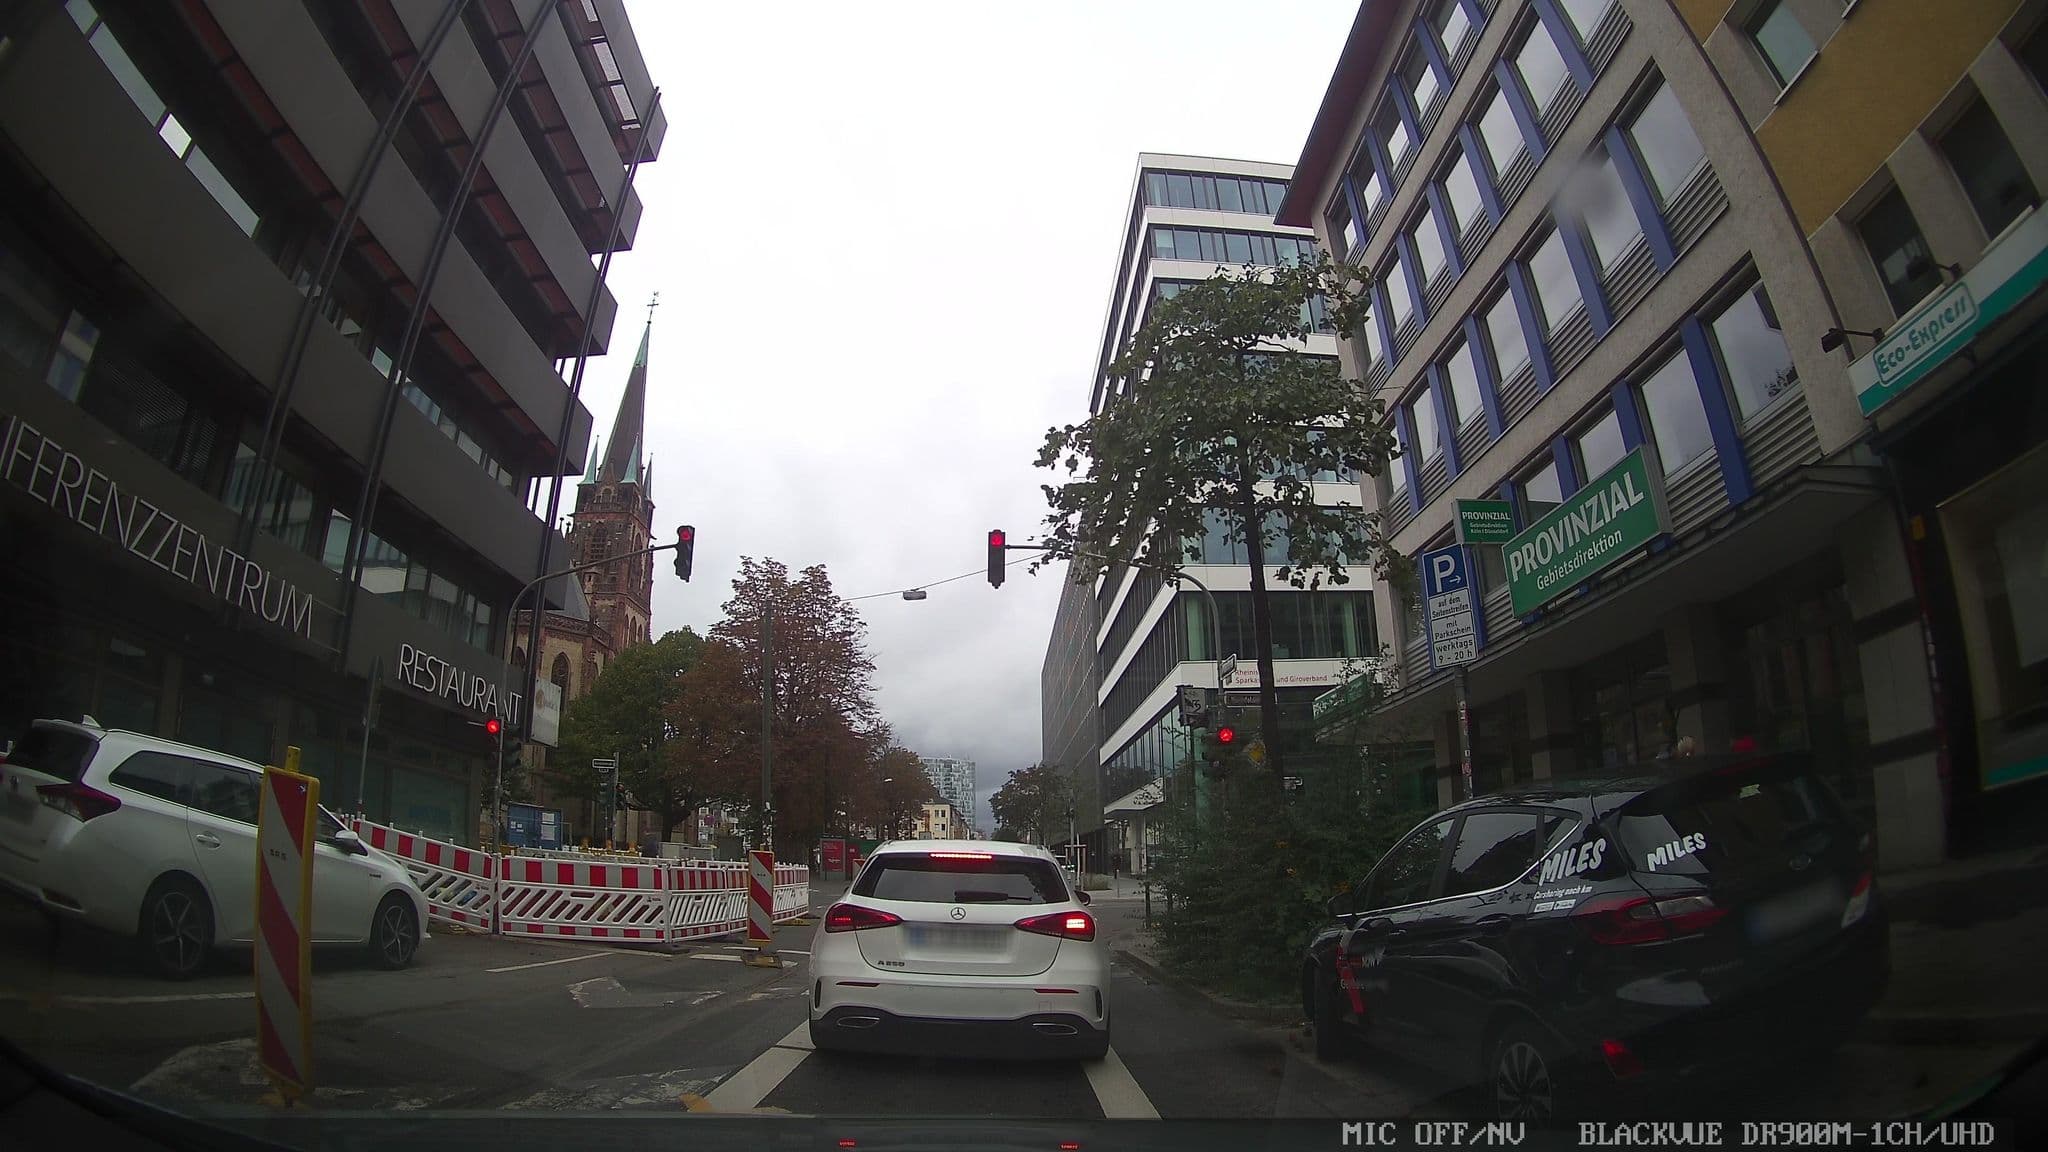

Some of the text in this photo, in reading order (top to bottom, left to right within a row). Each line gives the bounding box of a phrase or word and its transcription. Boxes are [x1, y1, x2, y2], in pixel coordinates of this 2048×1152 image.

[1877, 296, 1967, 375] Eco-Express
[1461, 511, 1511, 520] PROVINZIAL
[1509, 471, 1645, 583] PROVINZIAL
[1433, 554, 1455, 593] P
[1536, 529, 1622, 590] Gebietsdirektion
[1435, 626, 1471, 640] Parkschein
[1446, 620, 1458, 628] mit
[1436, 640, 1473, 653] werktags
[1438, 654, 1444, 664] 9
[1454, 649, 1465, 661] 20
[1467, 648, 1473, 658] h
[398, 643, 523, 725] RESTAURANT
[1235, 677, 1259, 685] Sparka
[1539, 837, 1607, 886] MILES
[1646, 832, 1707, 872] MILES
